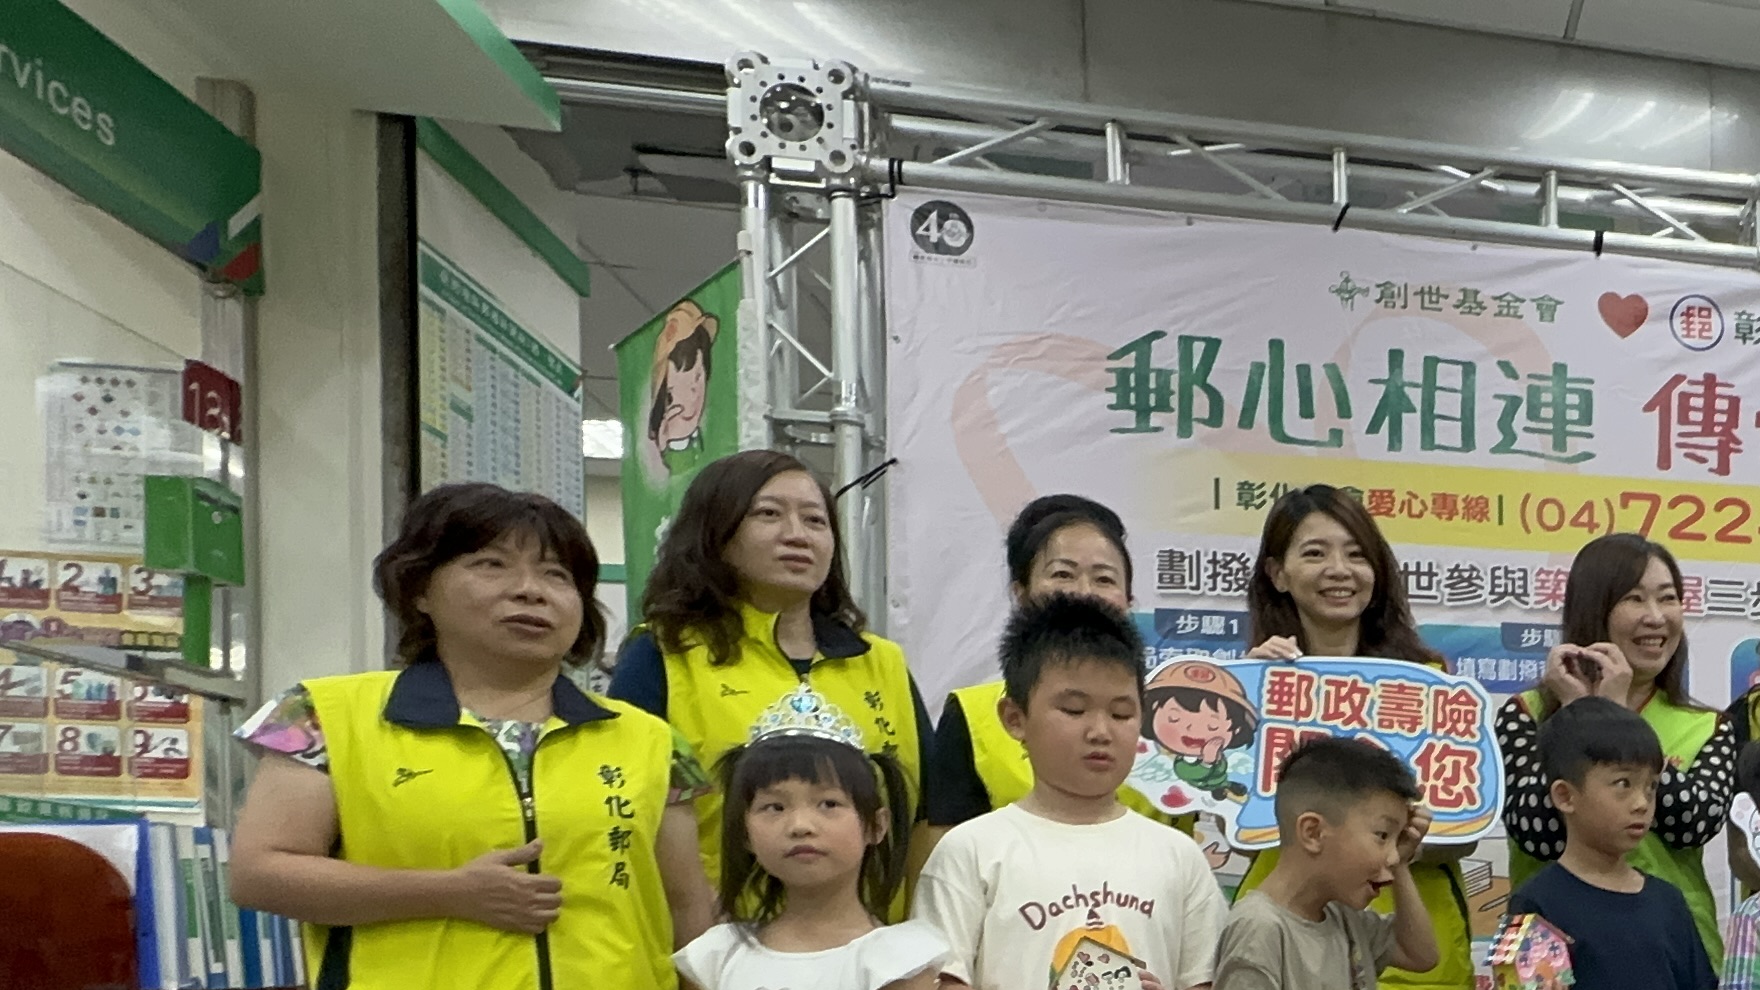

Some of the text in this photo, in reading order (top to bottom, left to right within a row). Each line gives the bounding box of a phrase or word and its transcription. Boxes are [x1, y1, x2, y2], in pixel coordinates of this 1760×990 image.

[1374, 278, 1567, 324] 創世基金會
[1106, 329, 1598, 465] 郵心相連
[1265, 669, 1480, 741] 郵政壽險
[596, 764, 635, 890] 彰化郵局
[1018, 880, 1155, 931] Dachshund
